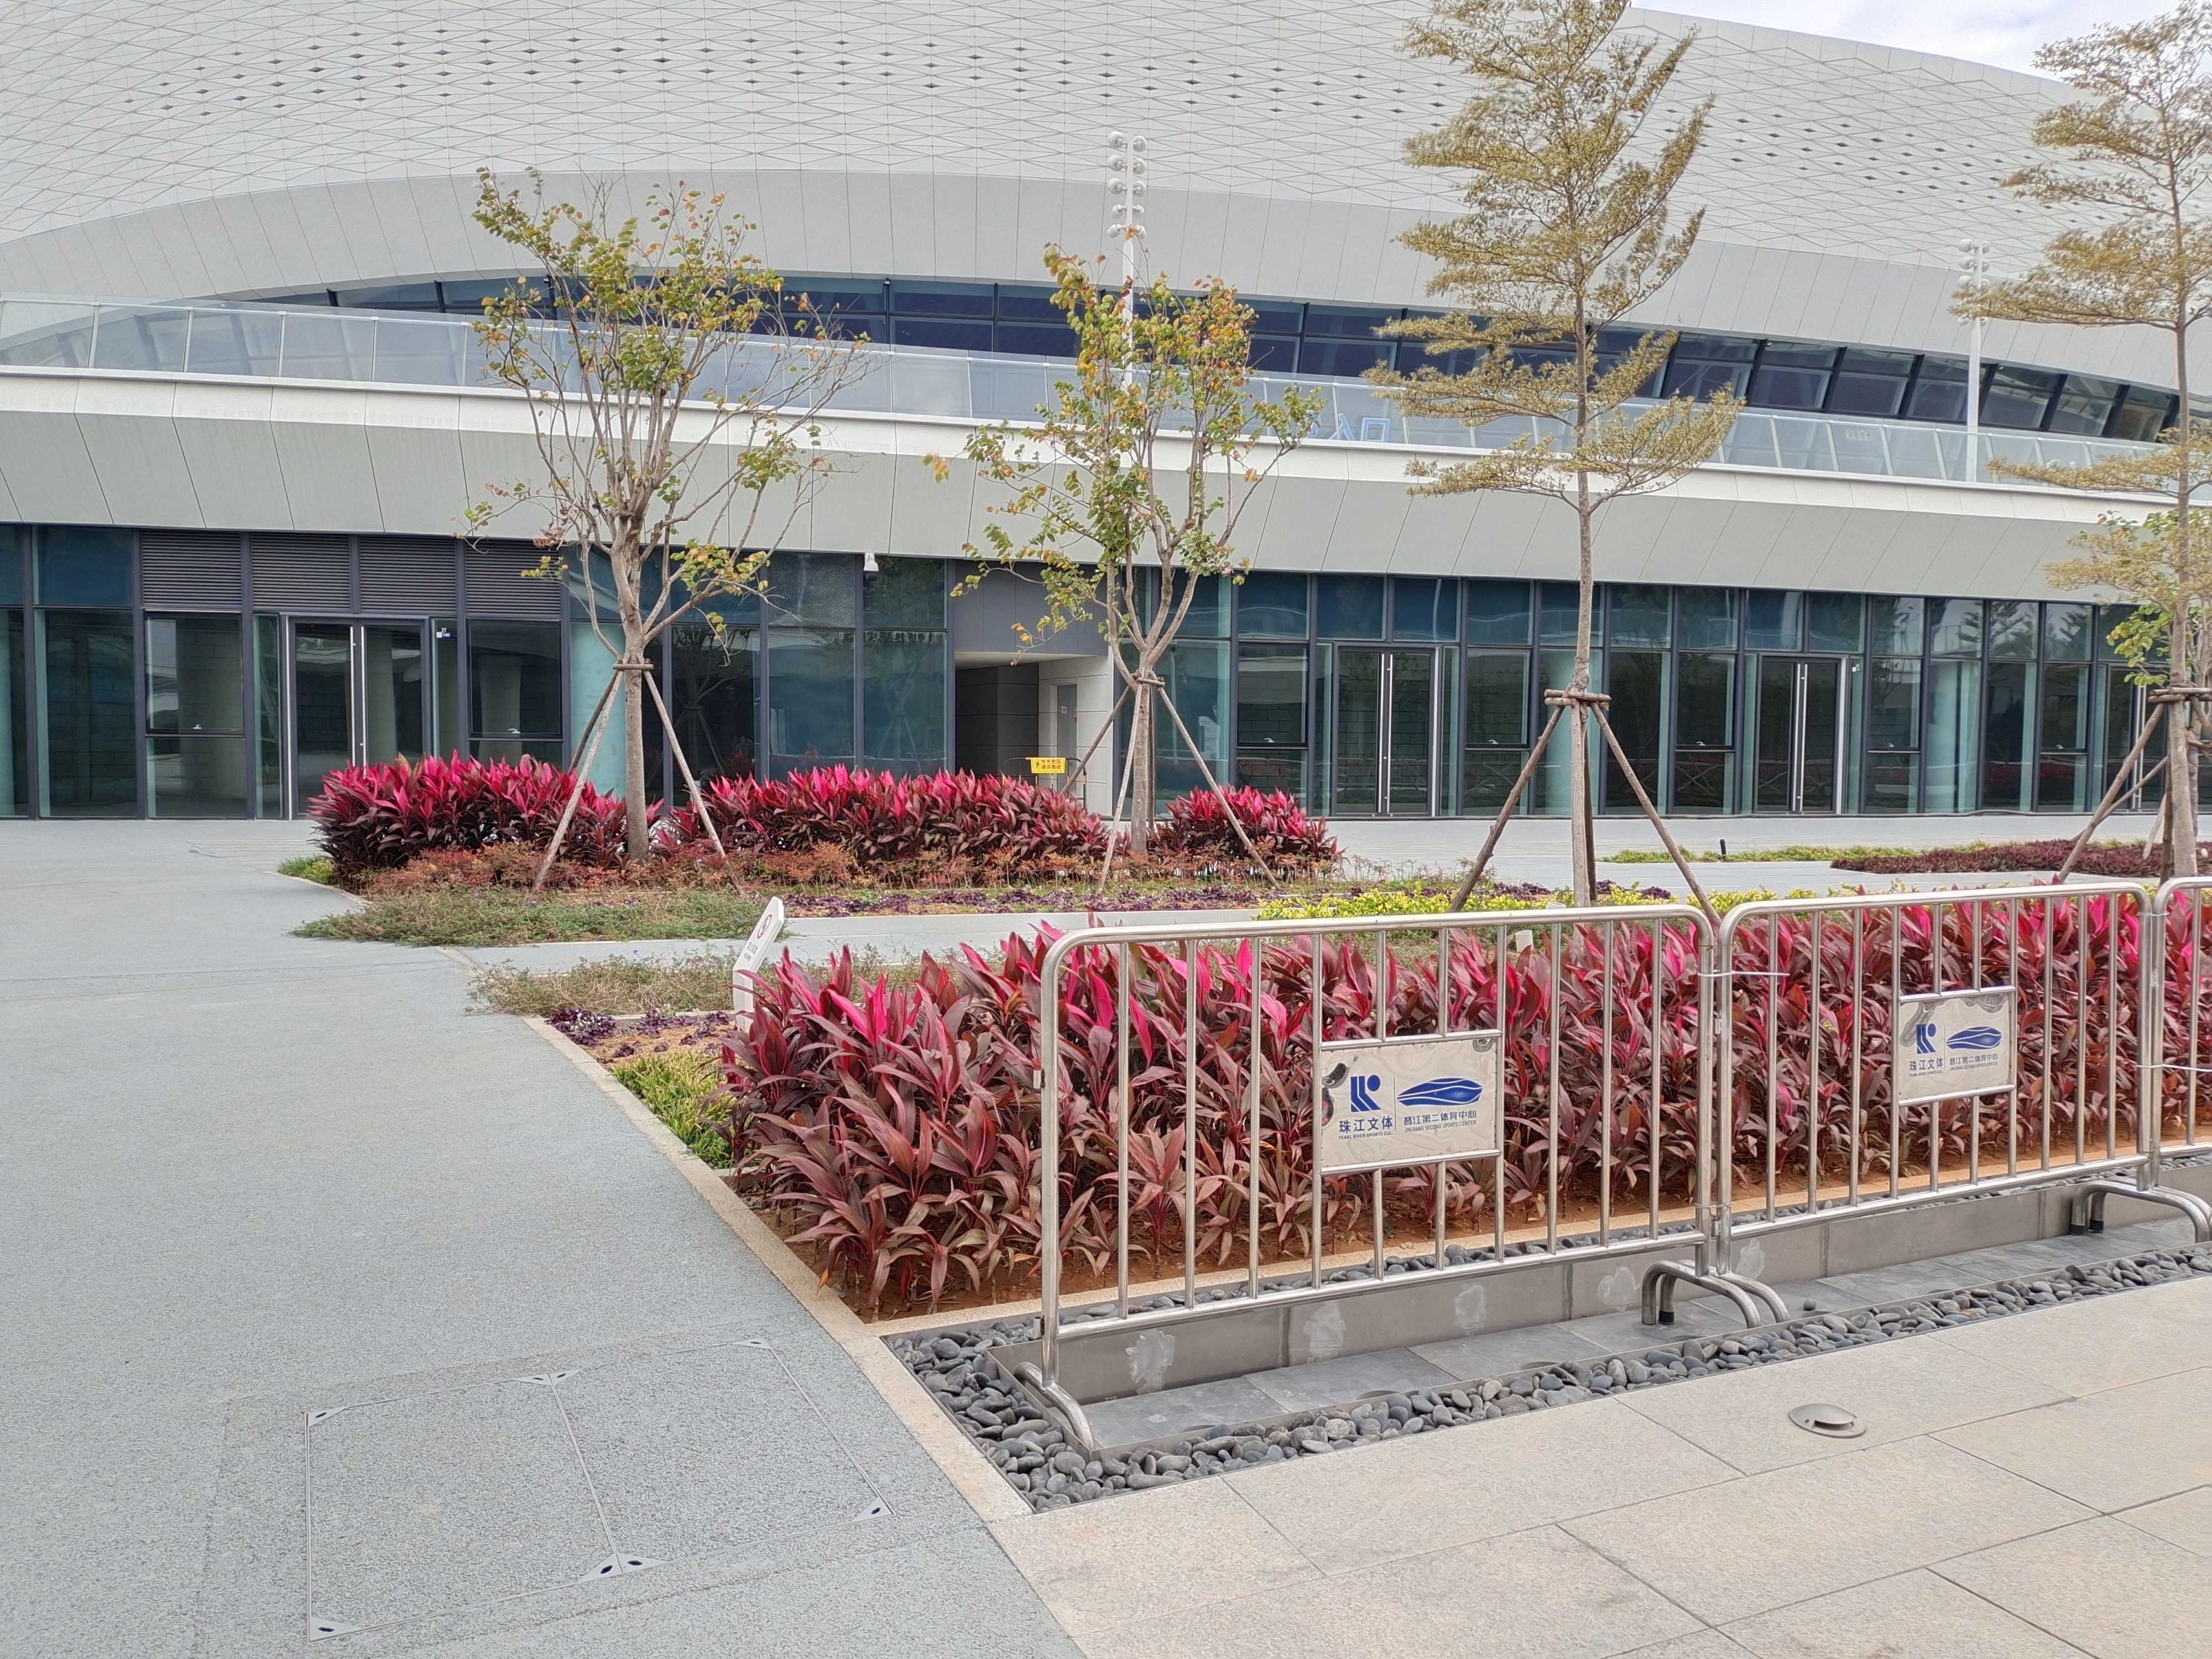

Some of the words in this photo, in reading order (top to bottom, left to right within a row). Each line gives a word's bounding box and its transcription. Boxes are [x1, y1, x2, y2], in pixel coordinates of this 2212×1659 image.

[1909, 1057, 1943, 1072] 珠江文体
[1950, 1053, 1998, 1065] 晋江第二体育中心
[1339, 1115, 1393, 1133] 珠江文体
[1404, 1110, 1477, 1125] 晋江第二体育中心
